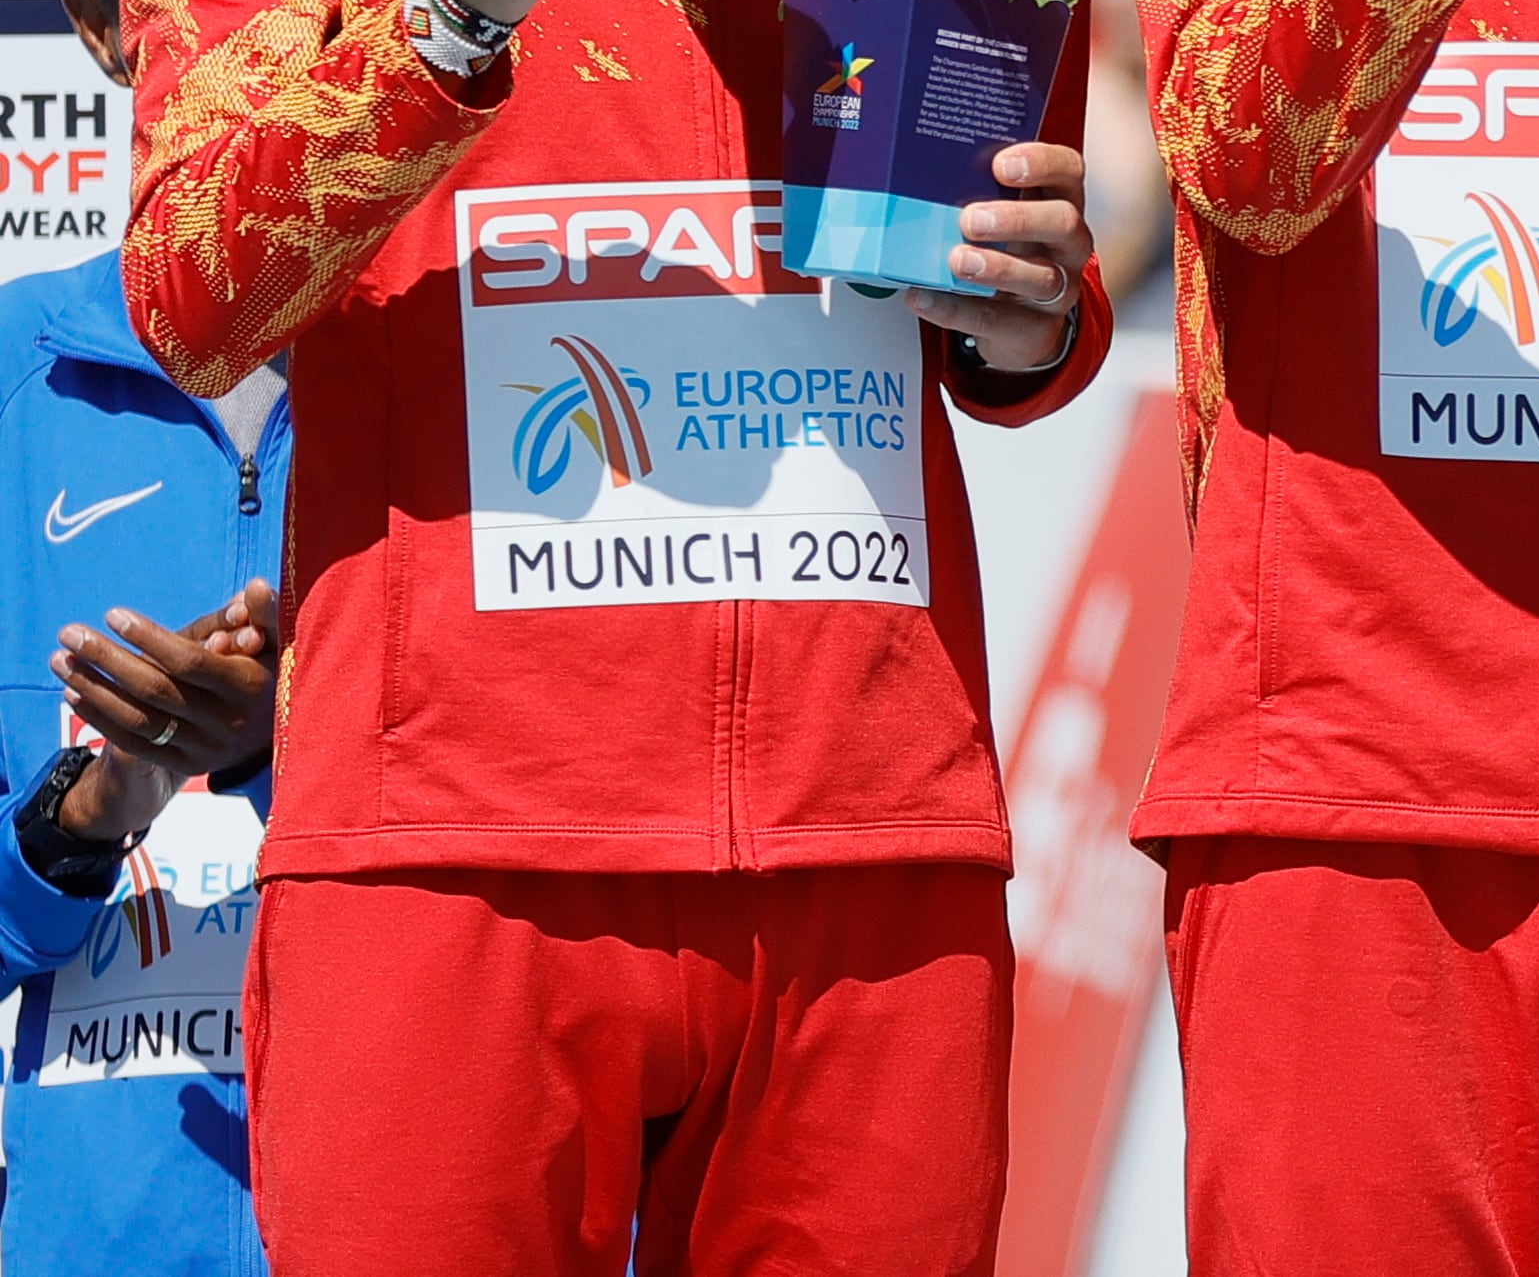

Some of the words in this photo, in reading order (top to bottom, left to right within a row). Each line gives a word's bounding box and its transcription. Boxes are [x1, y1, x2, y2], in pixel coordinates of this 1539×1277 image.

[813, 93, 862, 110] EUROPEAN
[675, 368, 904, 408] EUROPEAN
[676, 411, 905, 452] ATHLETICS
[508, 532, 762, 595] MUNICH
[788, 530, 911, 585] 2022
